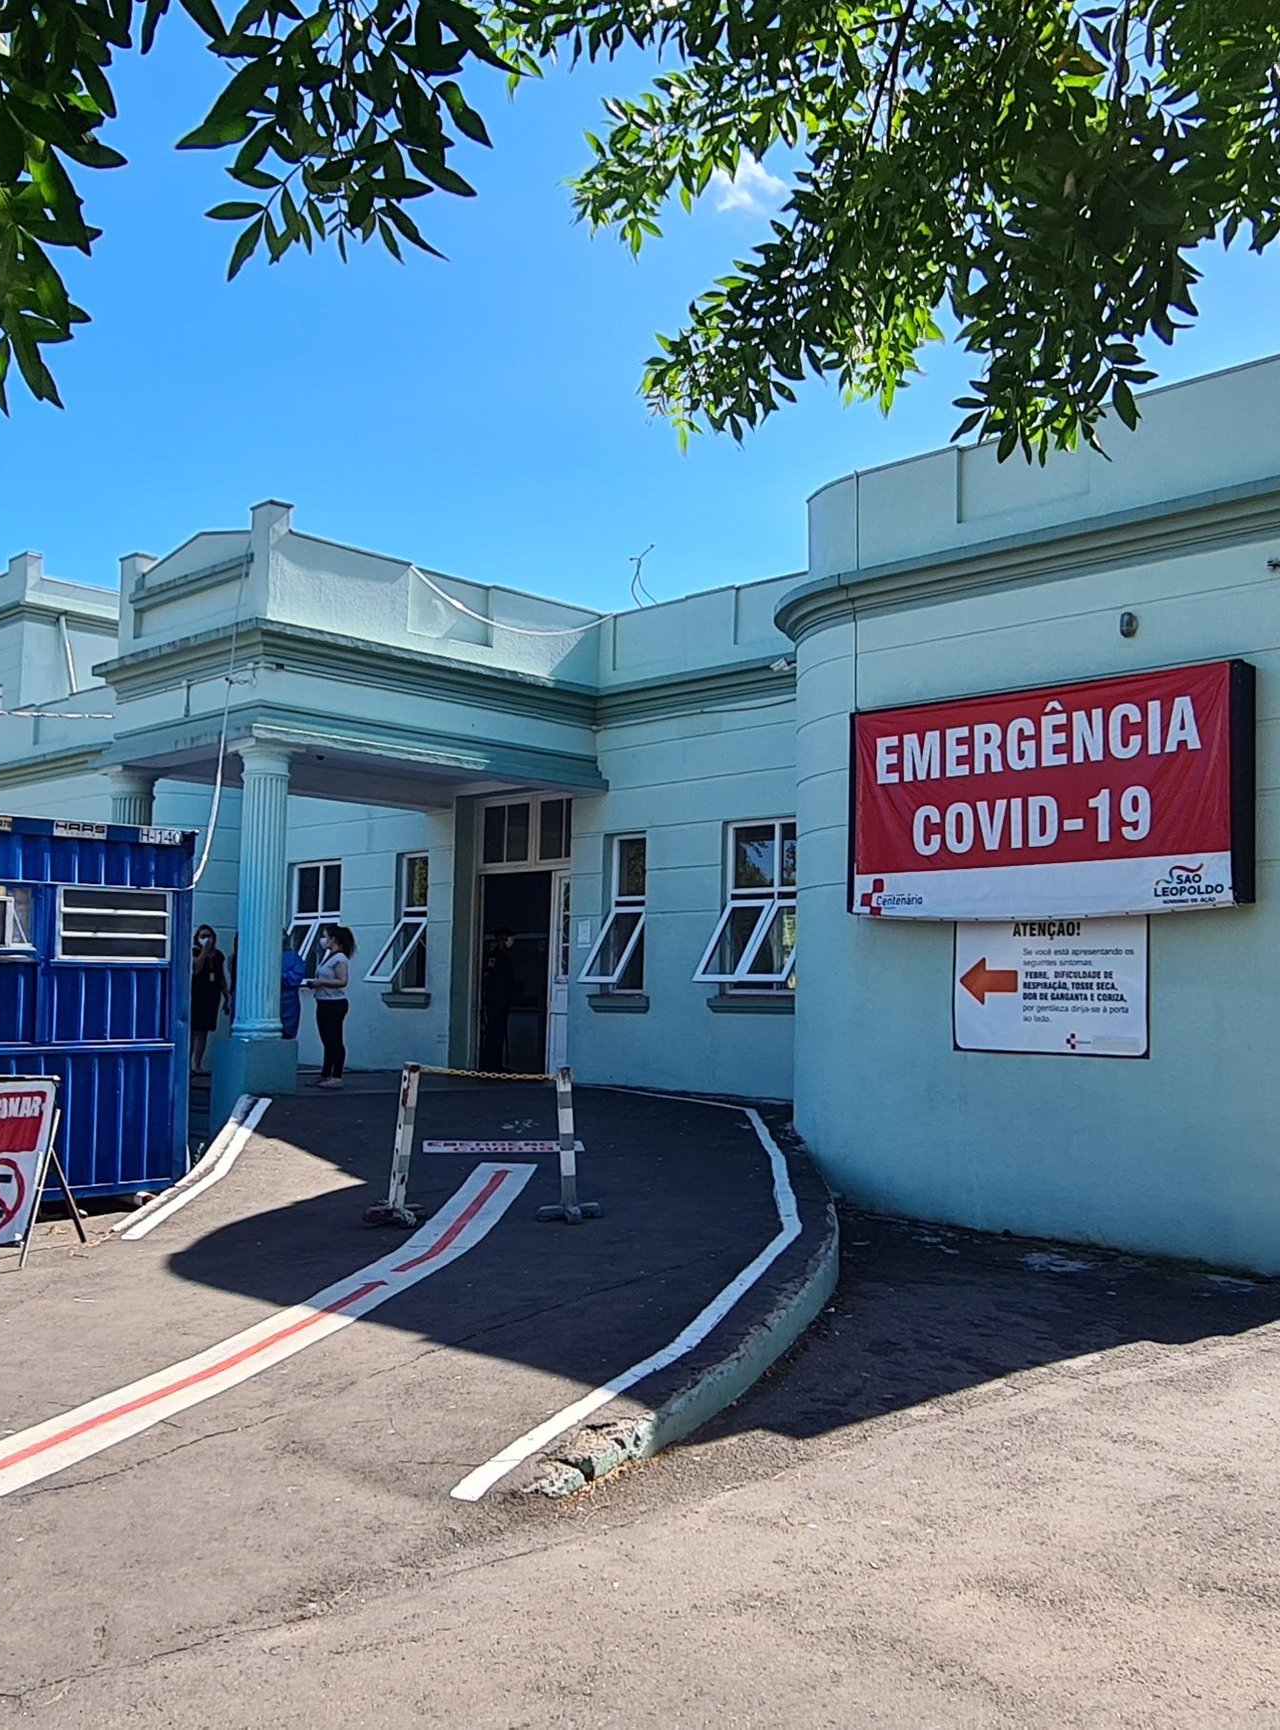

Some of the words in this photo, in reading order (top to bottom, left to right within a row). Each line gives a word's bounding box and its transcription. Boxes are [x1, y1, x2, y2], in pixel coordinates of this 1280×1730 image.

[876, 696, 1202, 785] EMERGÊNCIA
[913, 785, 1152, 856] COVID-19
[55, 822, 105, 834] HAAS
[1154, 884, 1224, 897] LEOPOLDO
[876, 895, 923, 906] Centenário
[1023, 948, 1032, 956] Se
[1035, 948, 1052, 956] você
[1054, 948, 1069, 956] está
[1071, 948, 1123, 957] apresentando
[1054, 971, 1101, 979] DIFICULDADE
[1104, 971, 1113, 979] DE
[1071, 982, 1094, 990] TOSSE
[1096, 983, 1118, 991] SECA,
[1050, 993, 1088, 1001] GARGANTA
[1090, 993, 1095, 1001] E
[1097, 994, 1127, 1002] CORIZA,
[1109, 1005, 1129, 1014] porta
